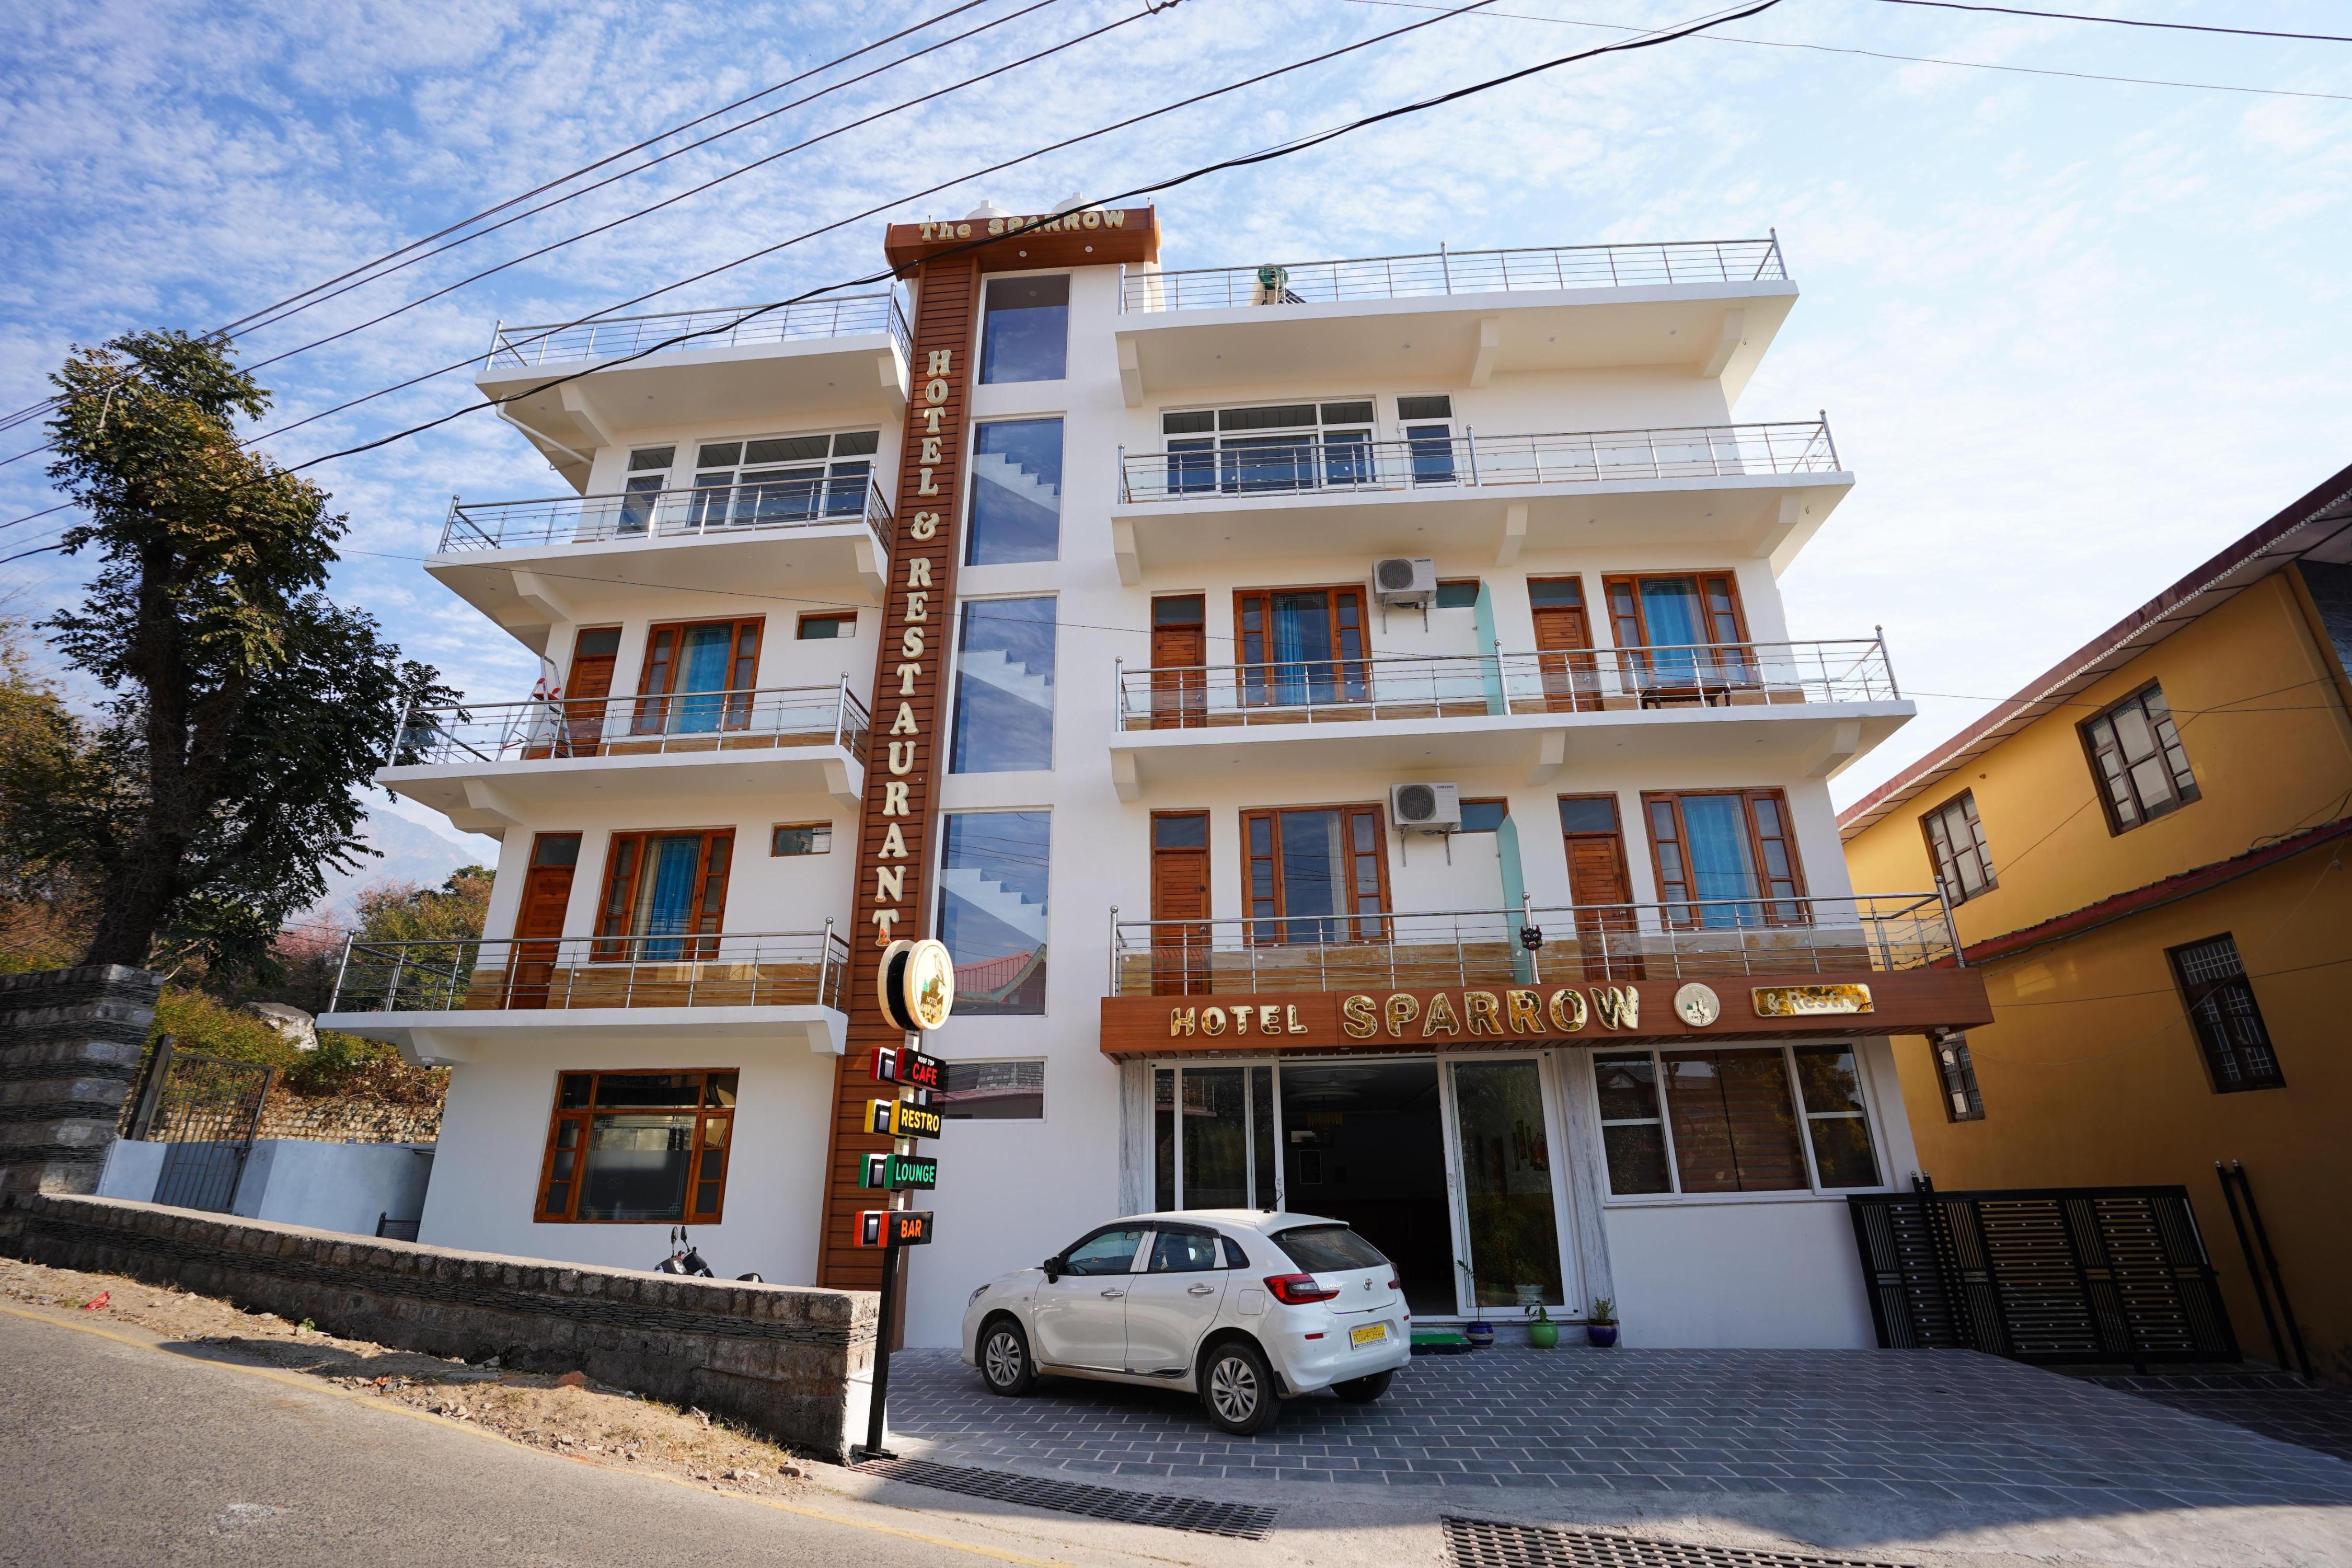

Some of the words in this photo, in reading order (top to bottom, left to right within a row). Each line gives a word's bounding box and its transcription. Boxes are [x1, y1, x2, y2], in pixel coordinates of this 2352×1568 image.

[919, 222, 972, 241] The
[987, 210, 1125, 236] SPARROW
[918, 349, 952, 497] HOTEL
[910, 511, 940, 542] &
[873, 557, 934, 947] RESTAURANT
[926, 995, 938, 1007] HOTEL
[1170, 1005, 1308, 1036] HOTEL
[1342, 986, 1639, 1039] SPARROW
[1767, 993, 1779, 1011] &
[1786, 991, 1861, 1009] Restro
[918, 1055, 927, 1064] ROOF
[913, 1063, 937, 1086] CAFE
[901, 1108, 939, 1132] RESTRO
[895, 1163, 935, 1183] LOUNGE
[901, 1219, 922, 1238] BAR
